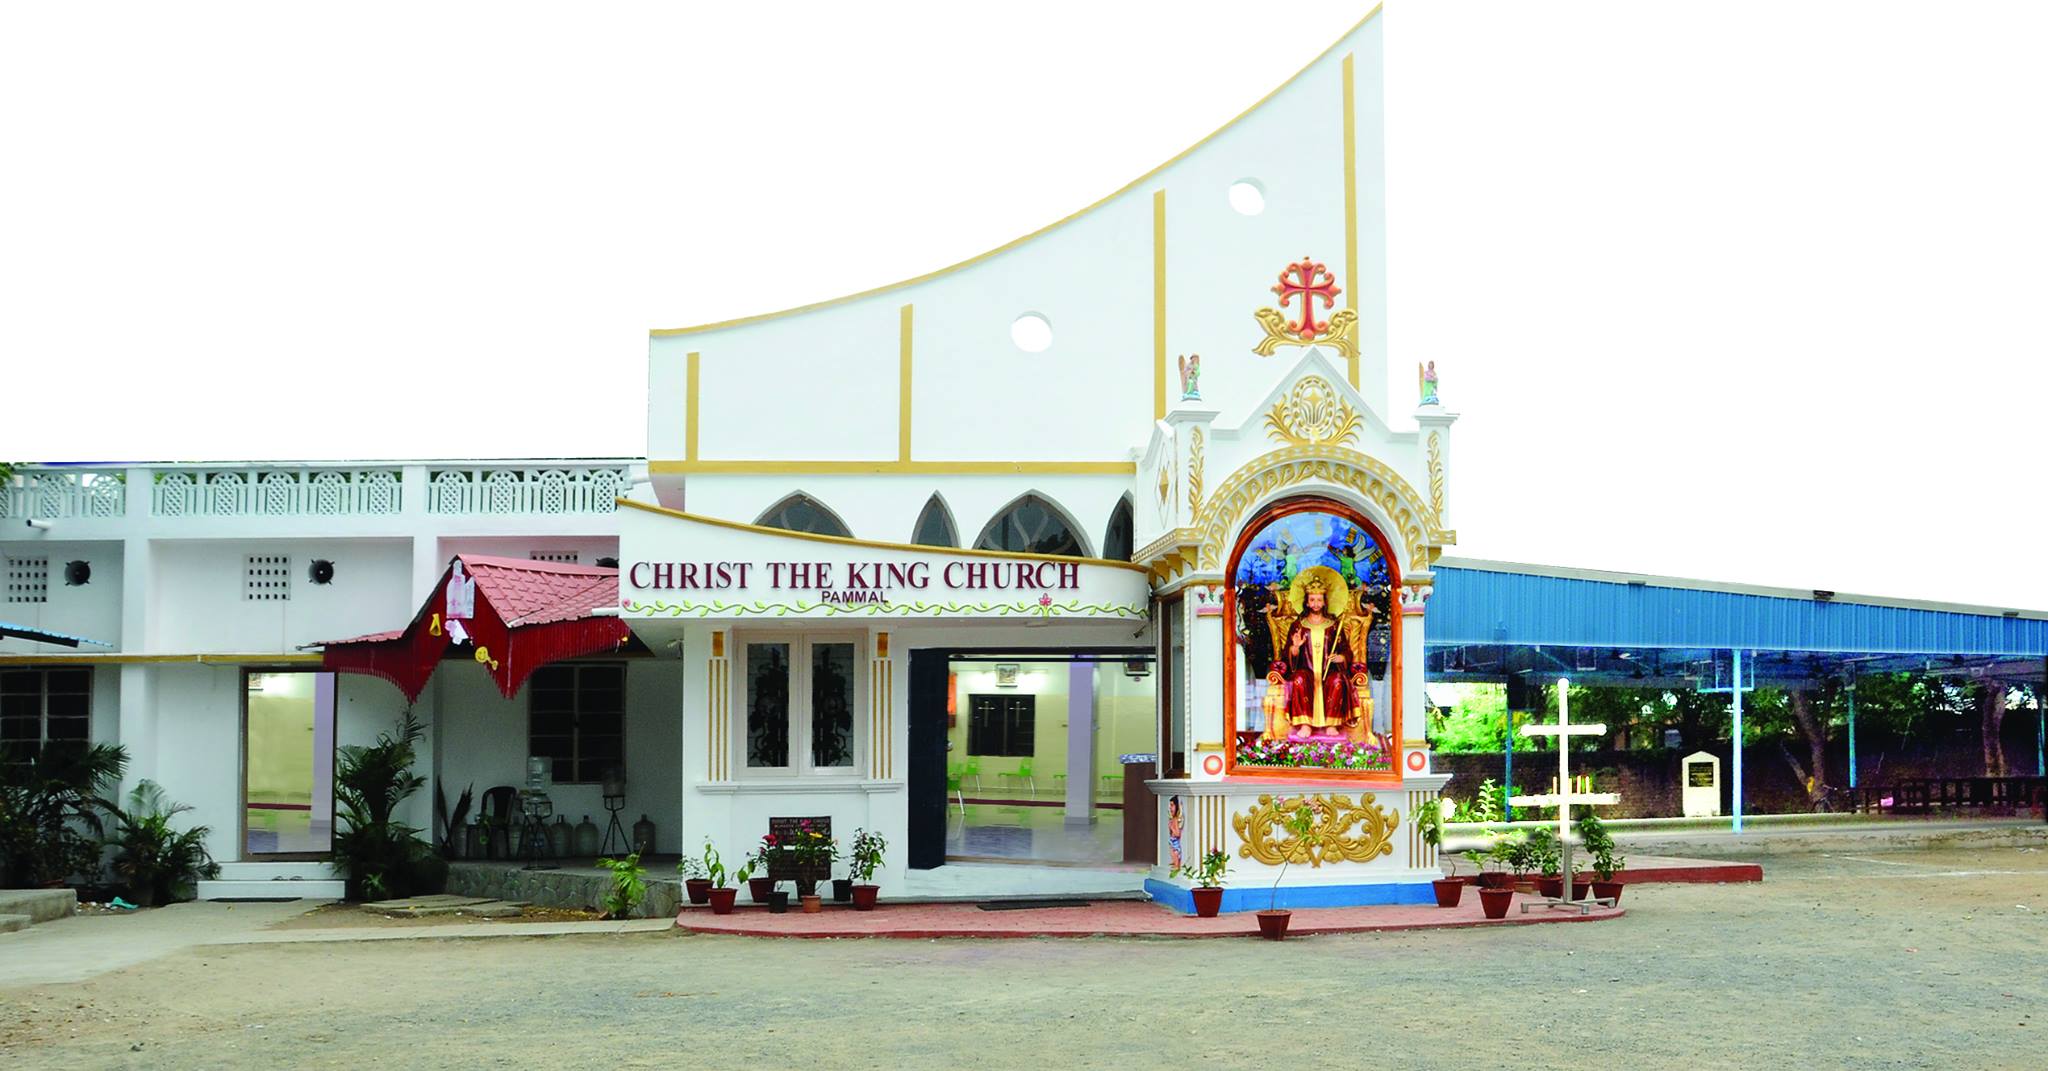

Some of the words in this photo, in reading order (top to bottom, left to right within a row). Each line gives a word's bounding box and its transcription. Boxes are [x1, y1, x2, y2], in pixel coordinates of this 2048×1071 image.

[629, 561, 753, 590] CHRIST
[766, 562, 834, 589] THE
[846, 561, 930, 589] KING
[943, 561, 1080, 589] CHURCH
[821, 591, 889, 604] PAMMAL
